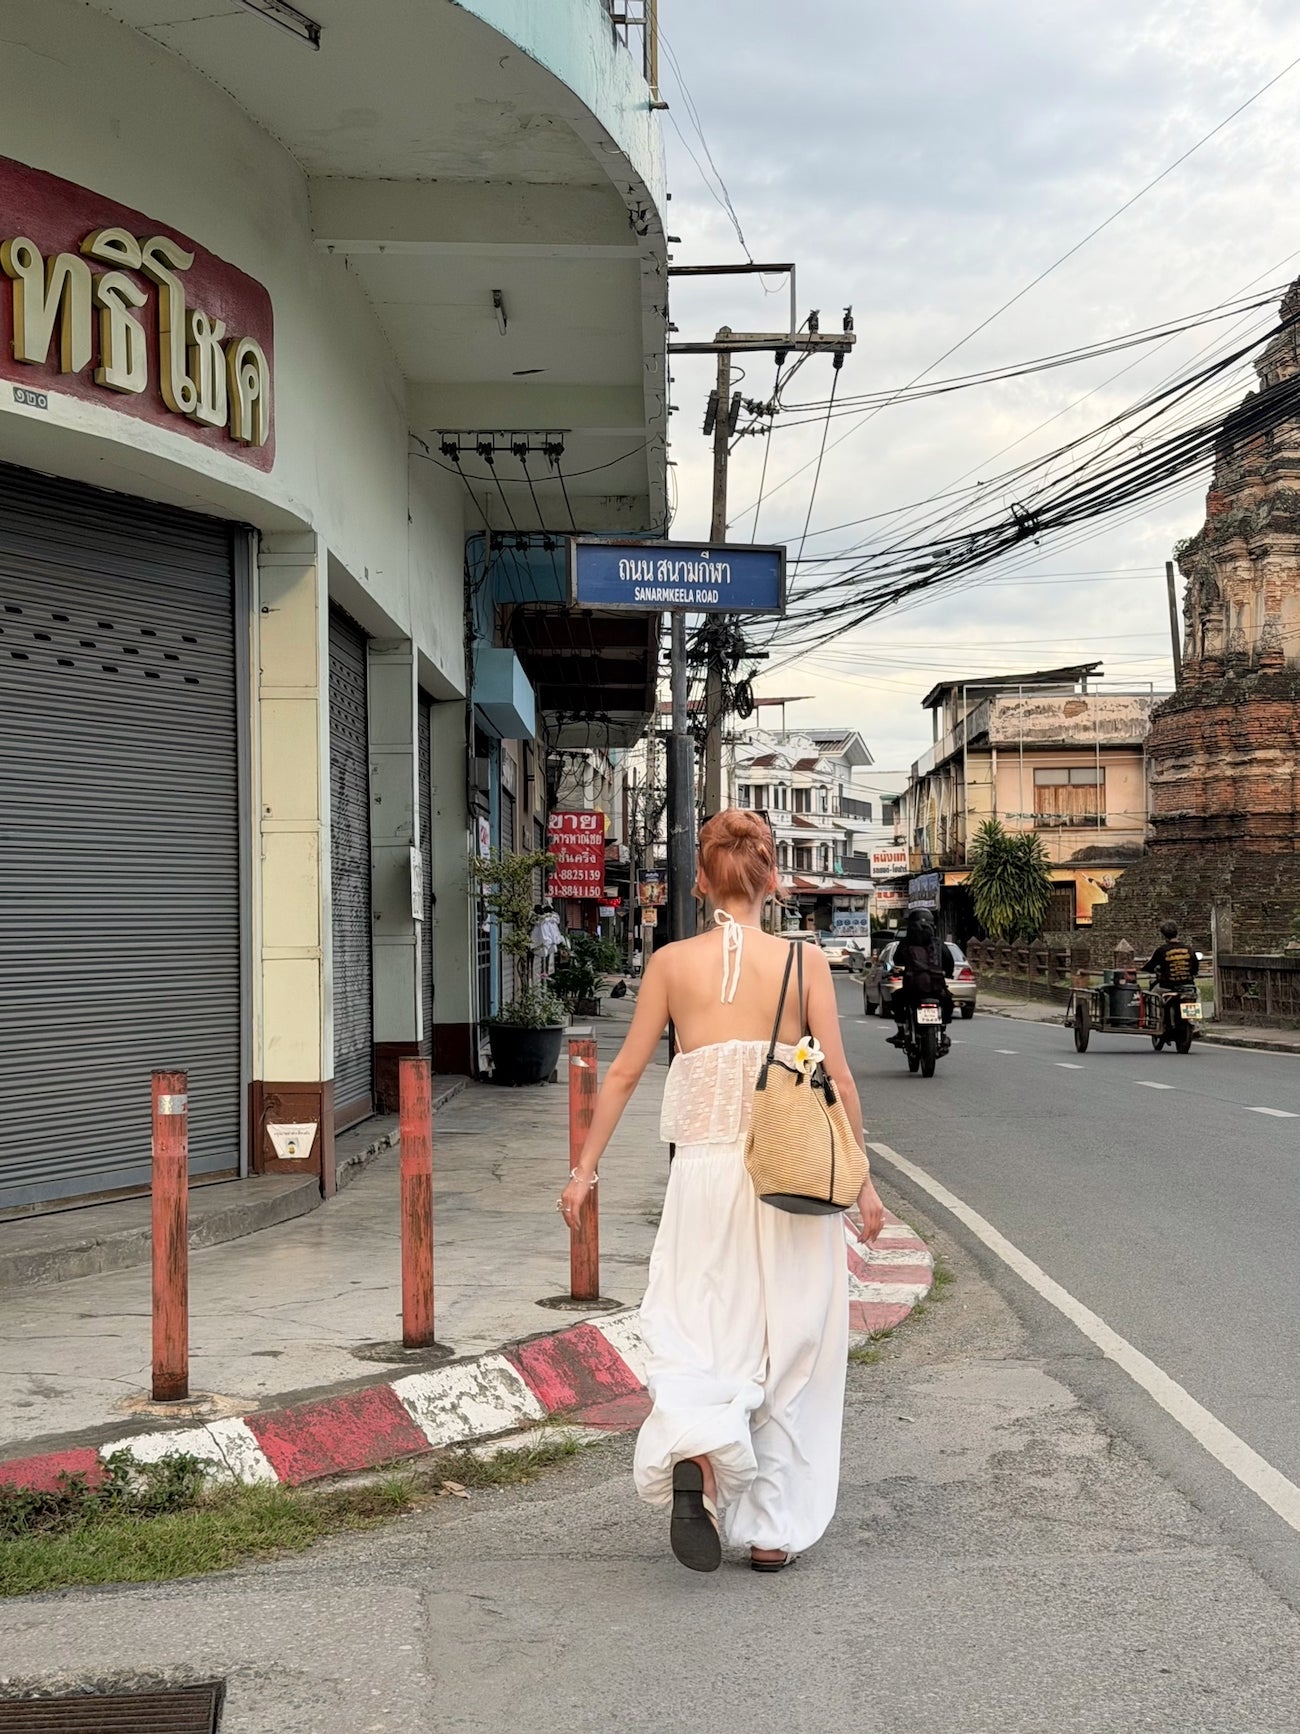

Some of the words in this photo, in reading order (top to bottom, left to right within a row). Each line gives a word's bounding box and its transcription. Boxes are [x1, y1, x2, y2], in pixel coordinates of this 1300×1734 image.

[618, 558, 654, 581] ถนน
[657, 550, 731, 584] สนามกีฬา
[634, 586, 694, 603] SANARMKEELA
[696, 589, 719, 604] ROAD
[548, 814, 597, 829] ขาย
